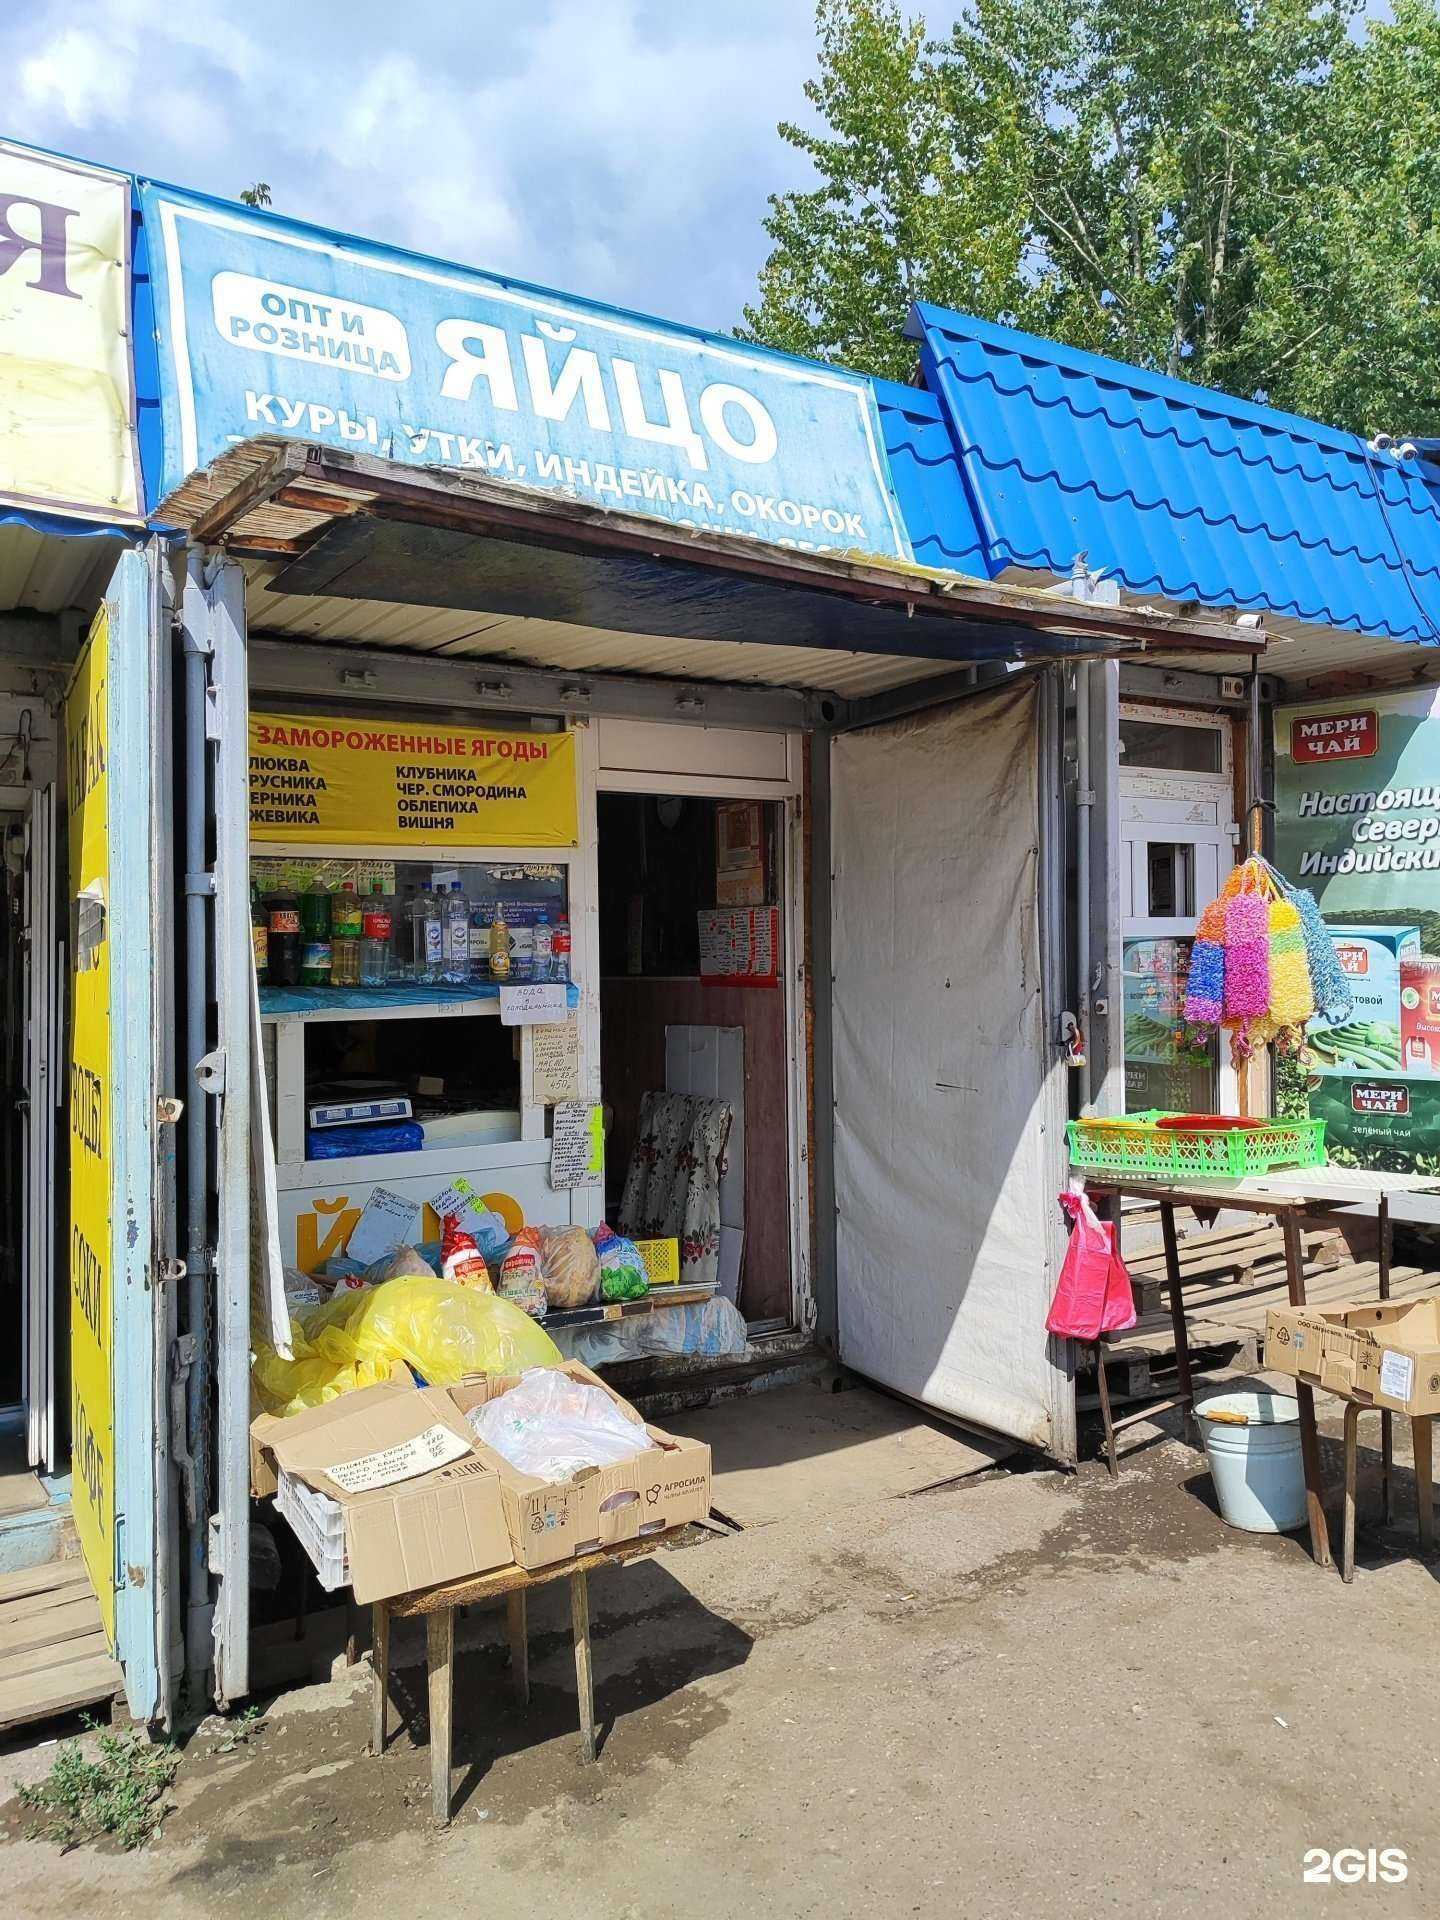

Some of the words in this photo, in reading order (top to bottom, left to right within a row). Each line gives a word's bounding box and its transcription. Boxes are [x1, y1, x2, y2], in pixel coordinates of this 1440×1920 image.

[261, 292, 331, 328] ОПТ
[341, 308, 365, 337] И
[230, 315, 401, 374] РОЗНИЦА
[435, 318, 778, 471] ЯЙЦО
[245, 390, 393, 456] КУРЫ,
[402, 423, 526, 477] УТКИ,
[537, 448, 725, 514] ИНДЕЙКА,
[731, 489, 865, 539] ОКОРОК
[1301, 717, 1368, 738] МЕРИ
[256, 725, 467, 756] ЗАМОРОЖЕННЫЕ
[471, 739, 548, 761] ЯГОДЫ
[1308, 735, 1360, 755] ЧАЙ
[249, 757, 310, 772] ЛЮКВА
[249, 774, 328, 790] РУСНИКА
[396, 765, 477, 782] КЛУБНИКА
[250, 791, 318, 807] ЕРНИКА
[396, 783, 430, 797] ЧЕР.
[432, 784, 527, 800] СМОРОДИНА
[397, 800, 478, 814] ОБЛЕПИХА
[249, 810, 320, 825] ЖЕВИКА
[398, 815, 455, 830] ВИШНЯ
[1352, 816, 1440, 844] Север
[1356, 1088, 1404, 1101] МЕРИ
[1361, 1099, 1398, 1111] ЧАЙ
[73, 1223, 102, 1349] СОКИ
[664, 1475, 706, 1493] АГРОСИЛА
